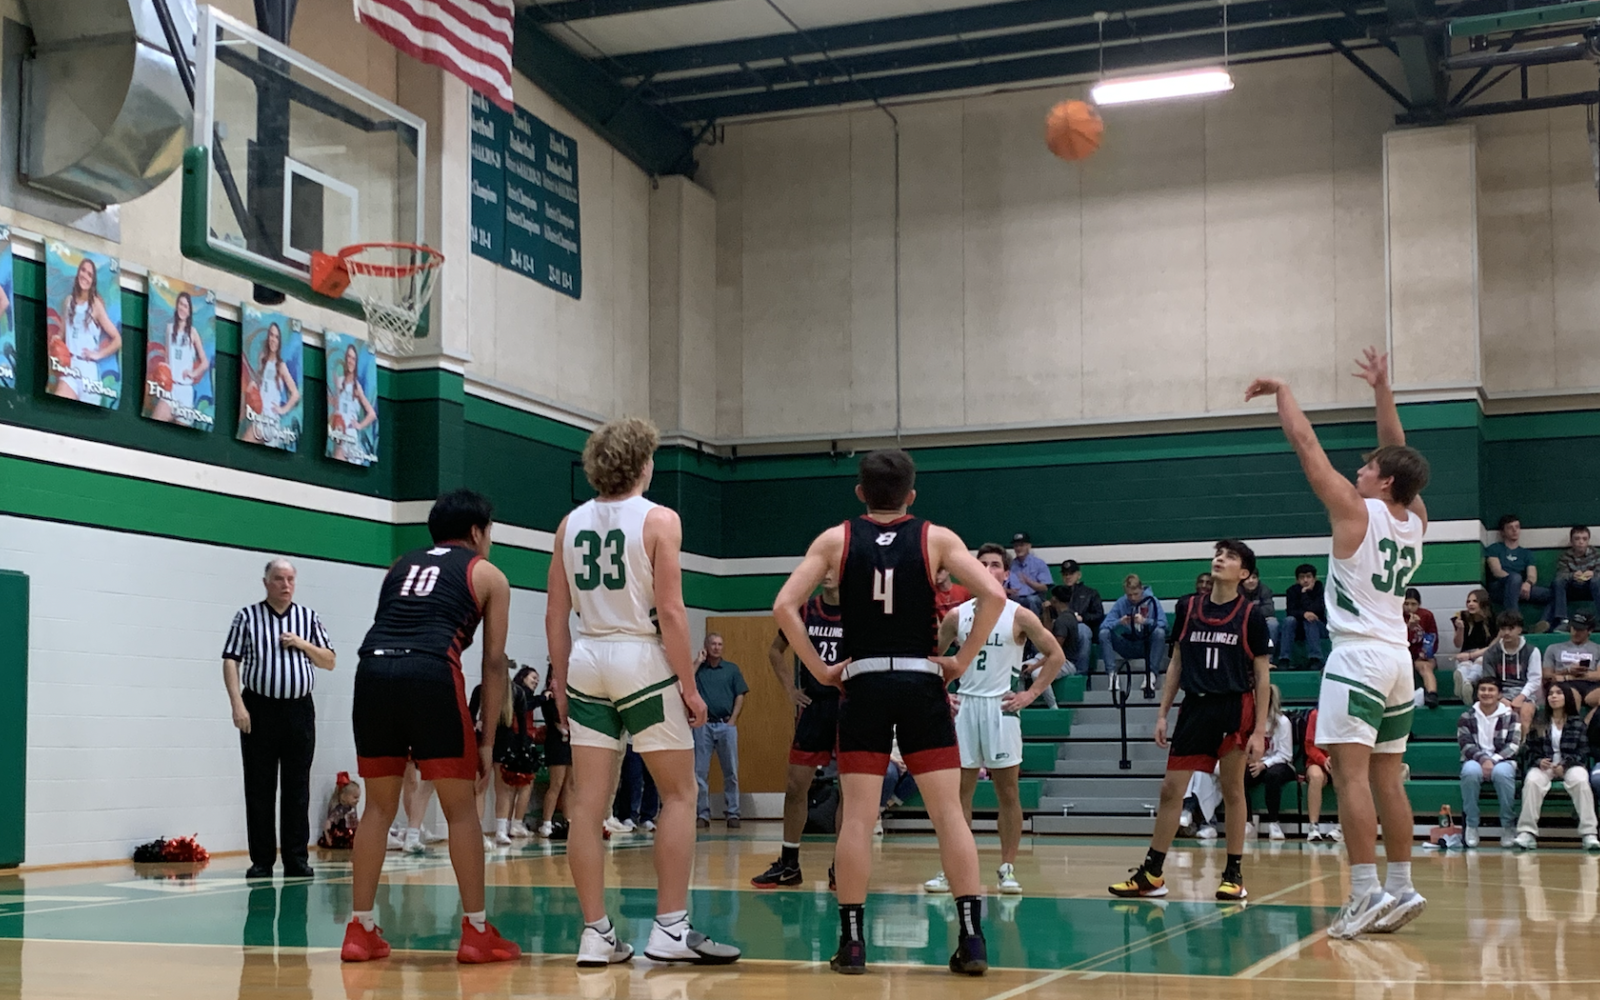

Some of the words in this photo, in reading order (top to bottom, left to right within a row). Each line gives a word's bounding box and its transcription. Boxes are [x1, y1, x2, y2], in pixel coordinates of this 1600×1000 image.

[574, 529, 626, 591] 33
[1371, 537, 1416, 597] 32
[400, 565, 440, 596] 10
[873, 567, 894, 614] 4
[819, 641, 838, 662] 23
[1190, 631, 1239, 646] BALLINGER
[976, 650, 988, 671] 2
[1206, 647, 1219, 669] 11
